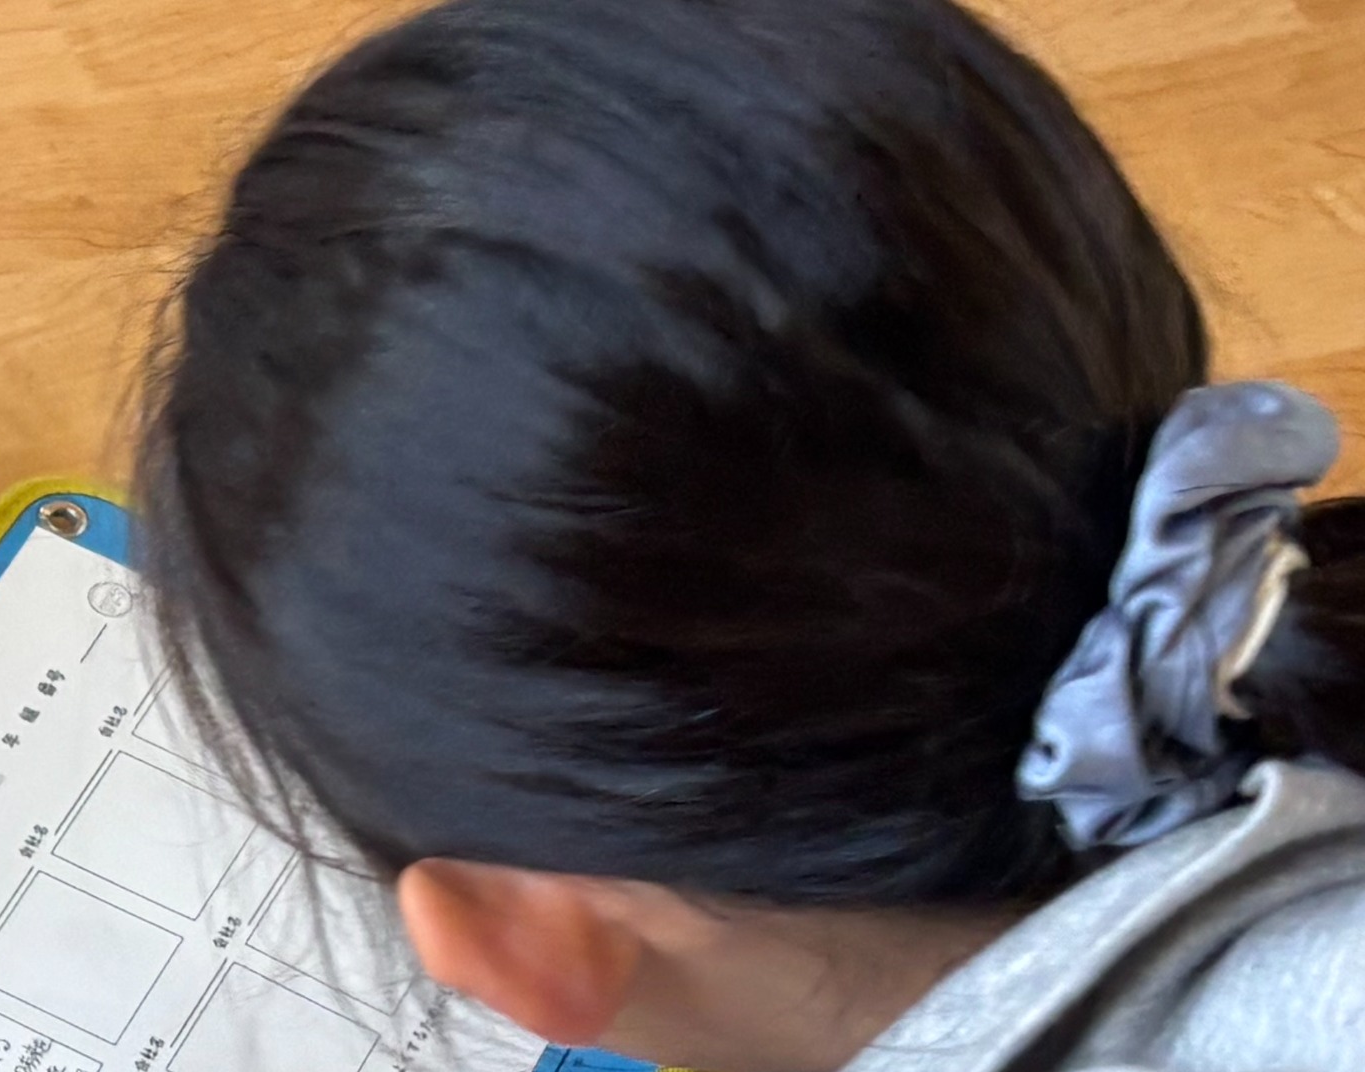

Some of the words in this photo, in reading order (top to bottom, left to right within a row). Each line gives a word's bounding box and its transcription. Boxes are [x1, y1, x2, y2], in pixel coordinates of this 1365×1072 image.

[1, 733, 20, 748] 年
[19, 707, 40, 723] 組
[38, 669, 65, 696] 番号
[99, 706, 128, 737] 会社名
[19, 824, 49, 858] 会社名
[135, 1036, 165, 1072] 会社名
